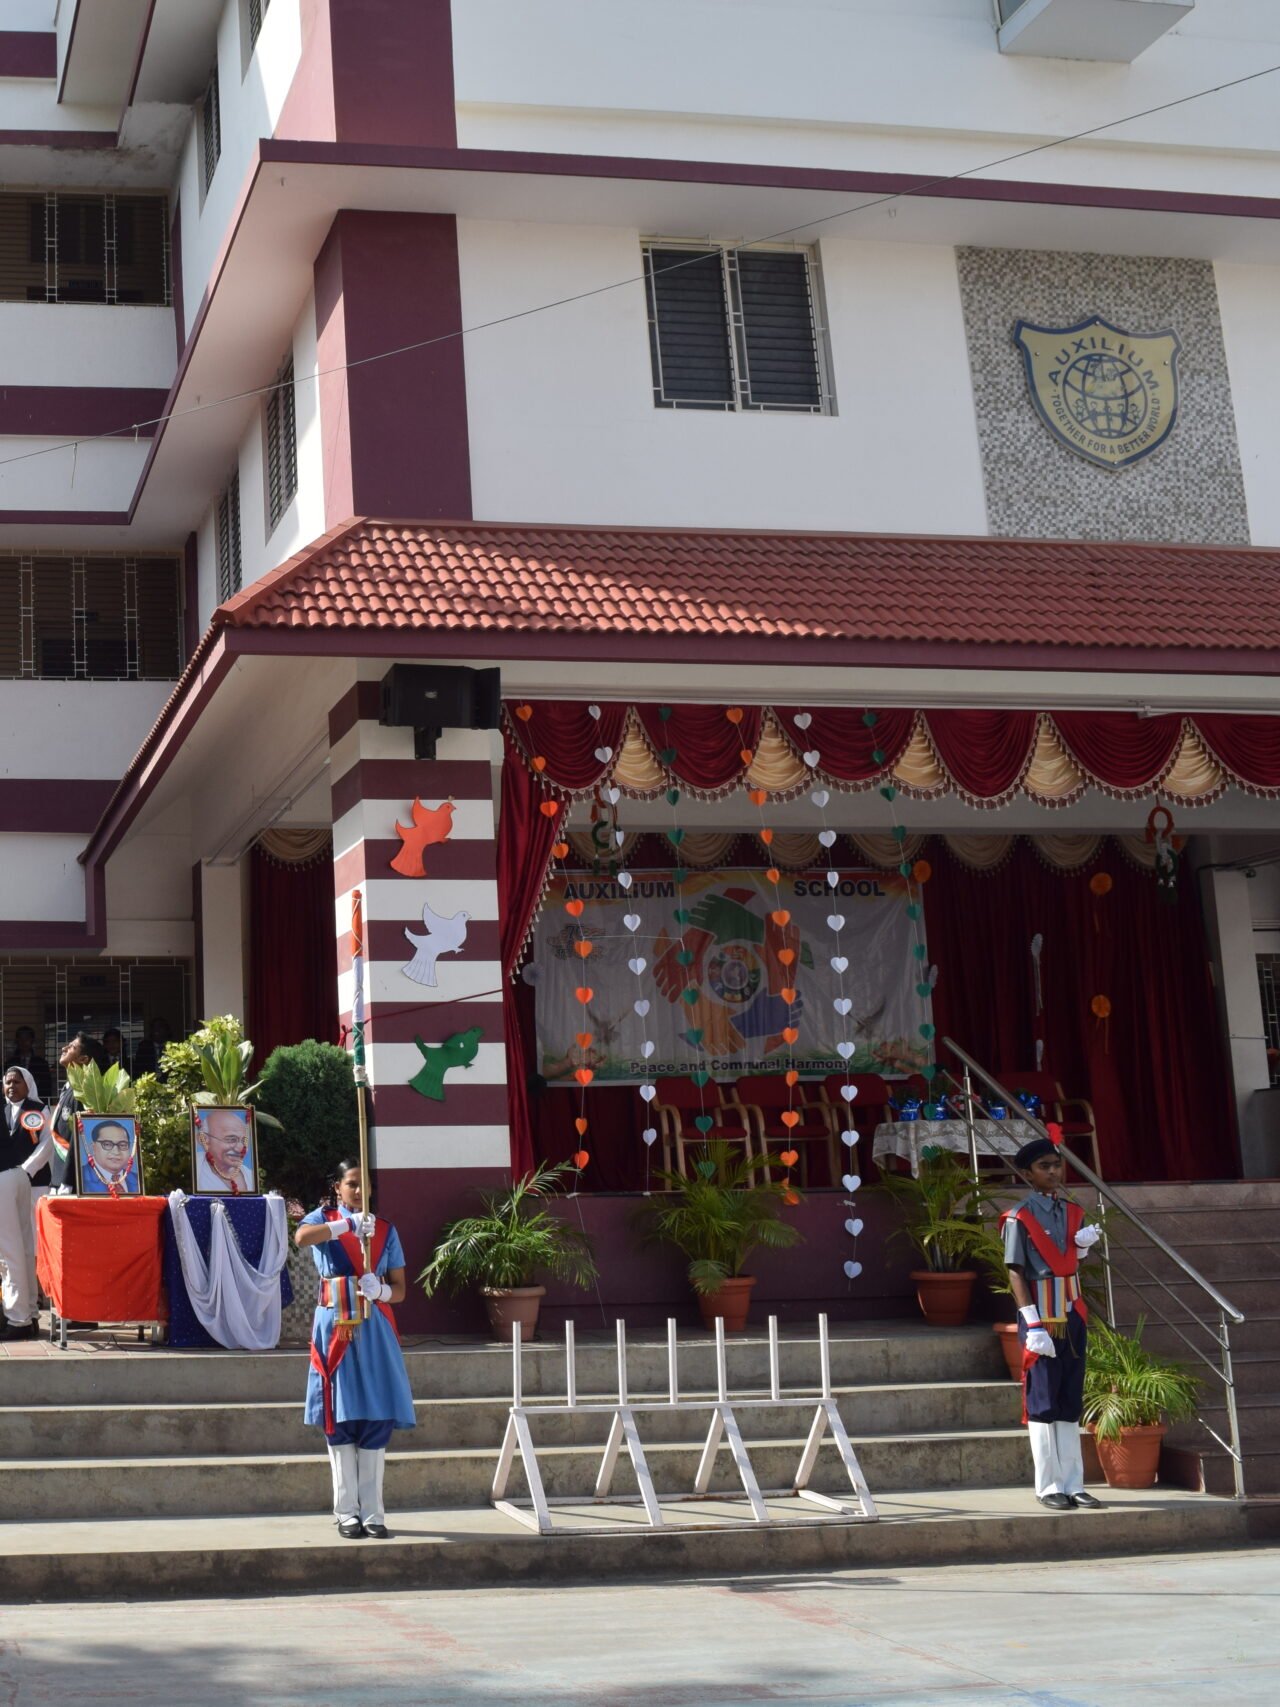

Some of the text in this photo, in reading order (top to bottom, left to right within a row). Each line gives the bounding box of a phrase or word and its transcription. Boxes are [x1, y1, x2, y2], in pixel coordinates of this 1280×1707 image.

[1048, 337, 1160, 390] AUXILIUM
[1050, 394, 1160, 455] TOGETHER FOR A BETTER WORLD
[563, 880, 885, 899] AUXILIUM SCHOOL
[630, 1058, 850, 1072] Peace and Communal Harmony
